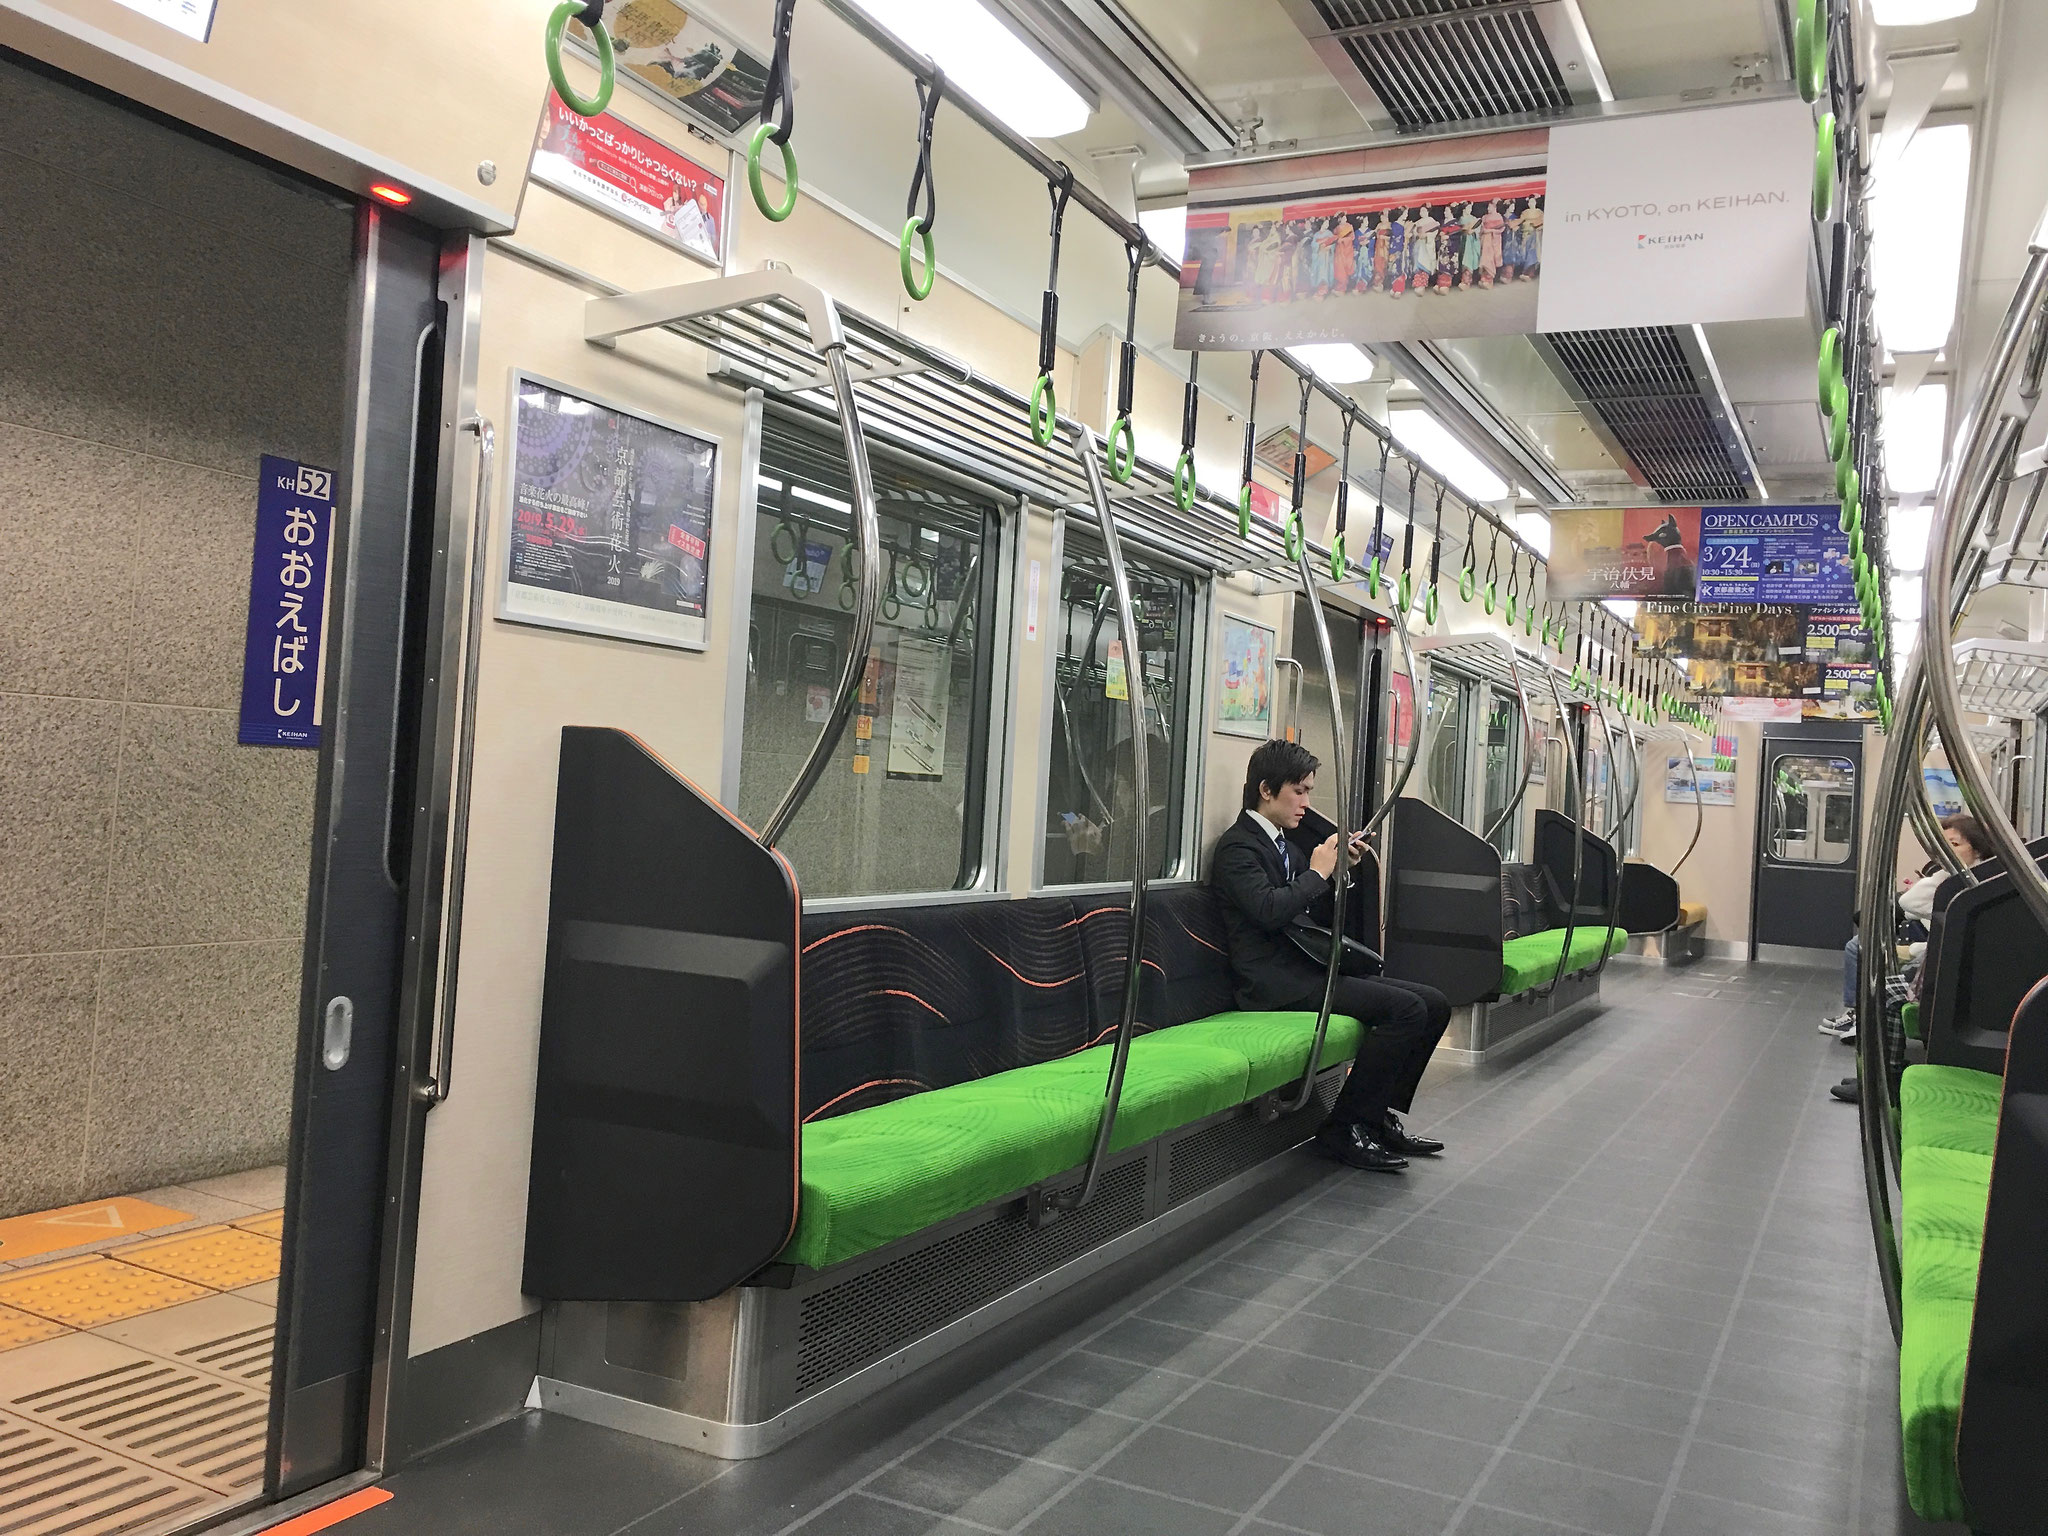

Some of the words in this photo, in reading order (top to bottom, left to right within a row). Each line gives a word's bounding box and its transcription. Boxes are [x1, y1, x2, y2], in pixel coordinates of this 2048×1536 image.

[1565, 211, 1581, 223] in
[1587, 203, 1661, 221] KYOTO,
[1667, 203, 1691, 214] on
[1697, 191, 1790, 211] KEIHAN.
[1648, 233, 1704, 245] KEIHAN
[277, 475, 295, 491] KH
[300, 471, 328, 498] 52
[608, 445, 629, 575] 京都芸術花火
[1704, 514, 1749, 527] OPEN
[1751, 513, 1819, 527] CAMPUS
[1703, 545, 1752, 568] 3/24
[607, 575, 621, 586] 2019
[1587, 566, 1656, 581] 宇治伏見
[273, 506, 317, 717] おおえばし
[1646, 601, 1679, 614] Fine
[1717, 601, 1752, 614] Fine
[1756, 602, 1792, 617] Days
